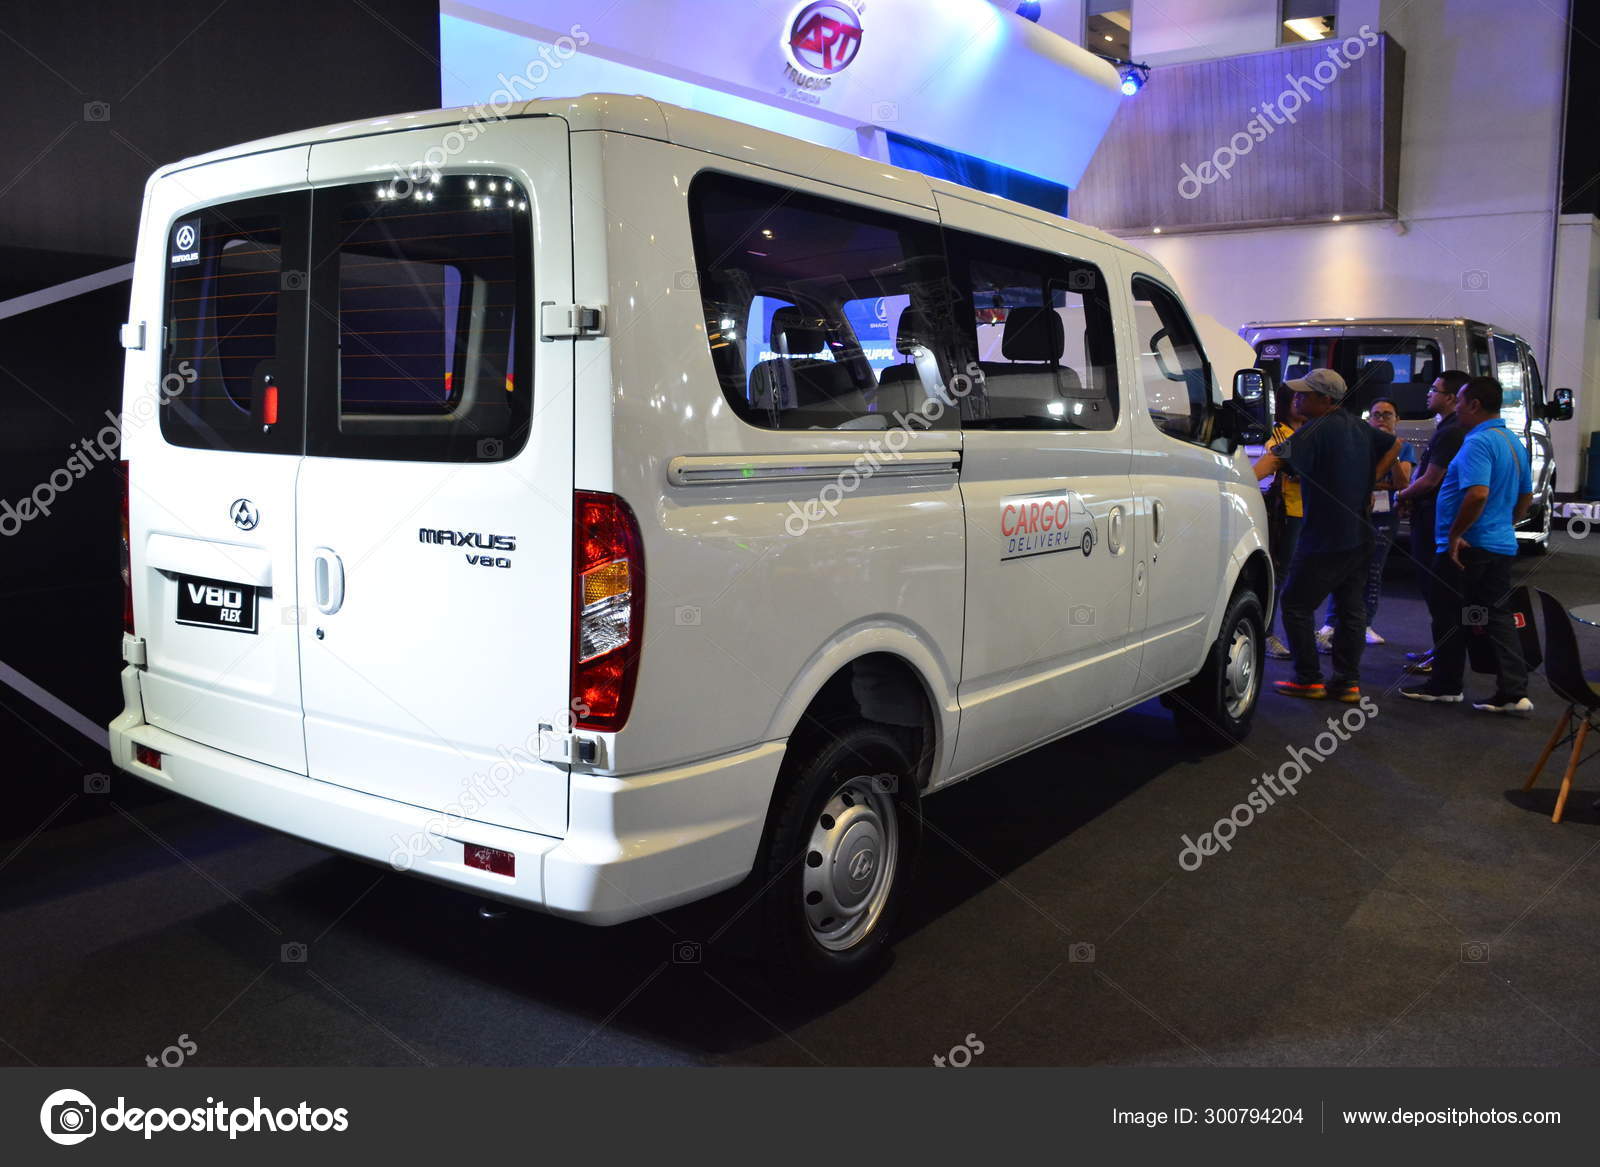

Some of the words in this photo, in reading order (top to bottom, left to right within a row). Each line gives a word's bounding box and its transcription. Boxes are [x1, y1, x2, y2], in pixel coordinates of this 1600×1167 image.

[788, 12, 864, 71] ART
[783, 61, 832, 91] TRUCKS
[1001, 500, 1069, 537] CARGO
[419, 527, 516, 552] MAXUS
[1008, 531, 1070, 553] DELIVERY
[465, 553, 511, 569] V80
[187, 582, 242, 609] V80
[220, 608, 242, 623] FLEX
